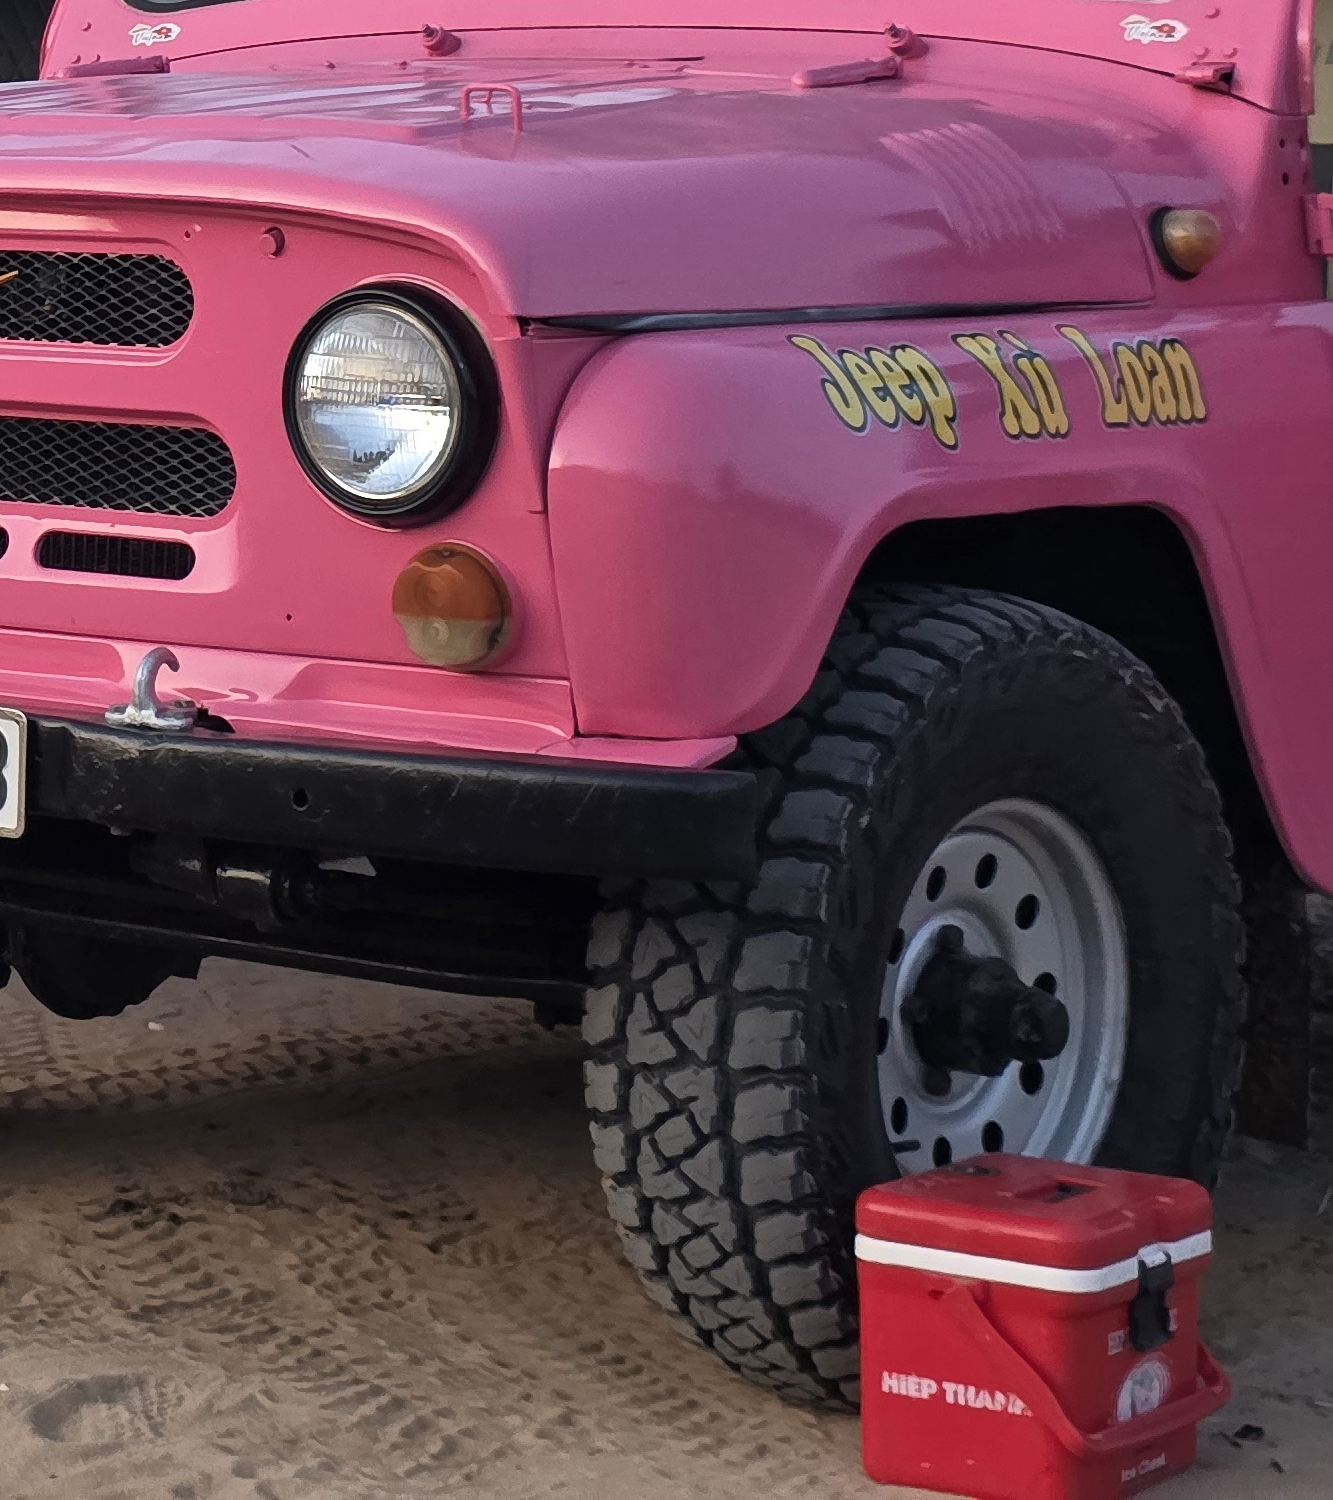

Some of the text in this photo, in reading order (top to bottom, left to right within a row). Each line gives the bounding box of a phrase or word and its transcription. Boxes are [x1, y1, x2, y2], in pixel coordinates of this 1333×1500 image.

[786, 324, 1208, 450] Jeep Xù Loan
